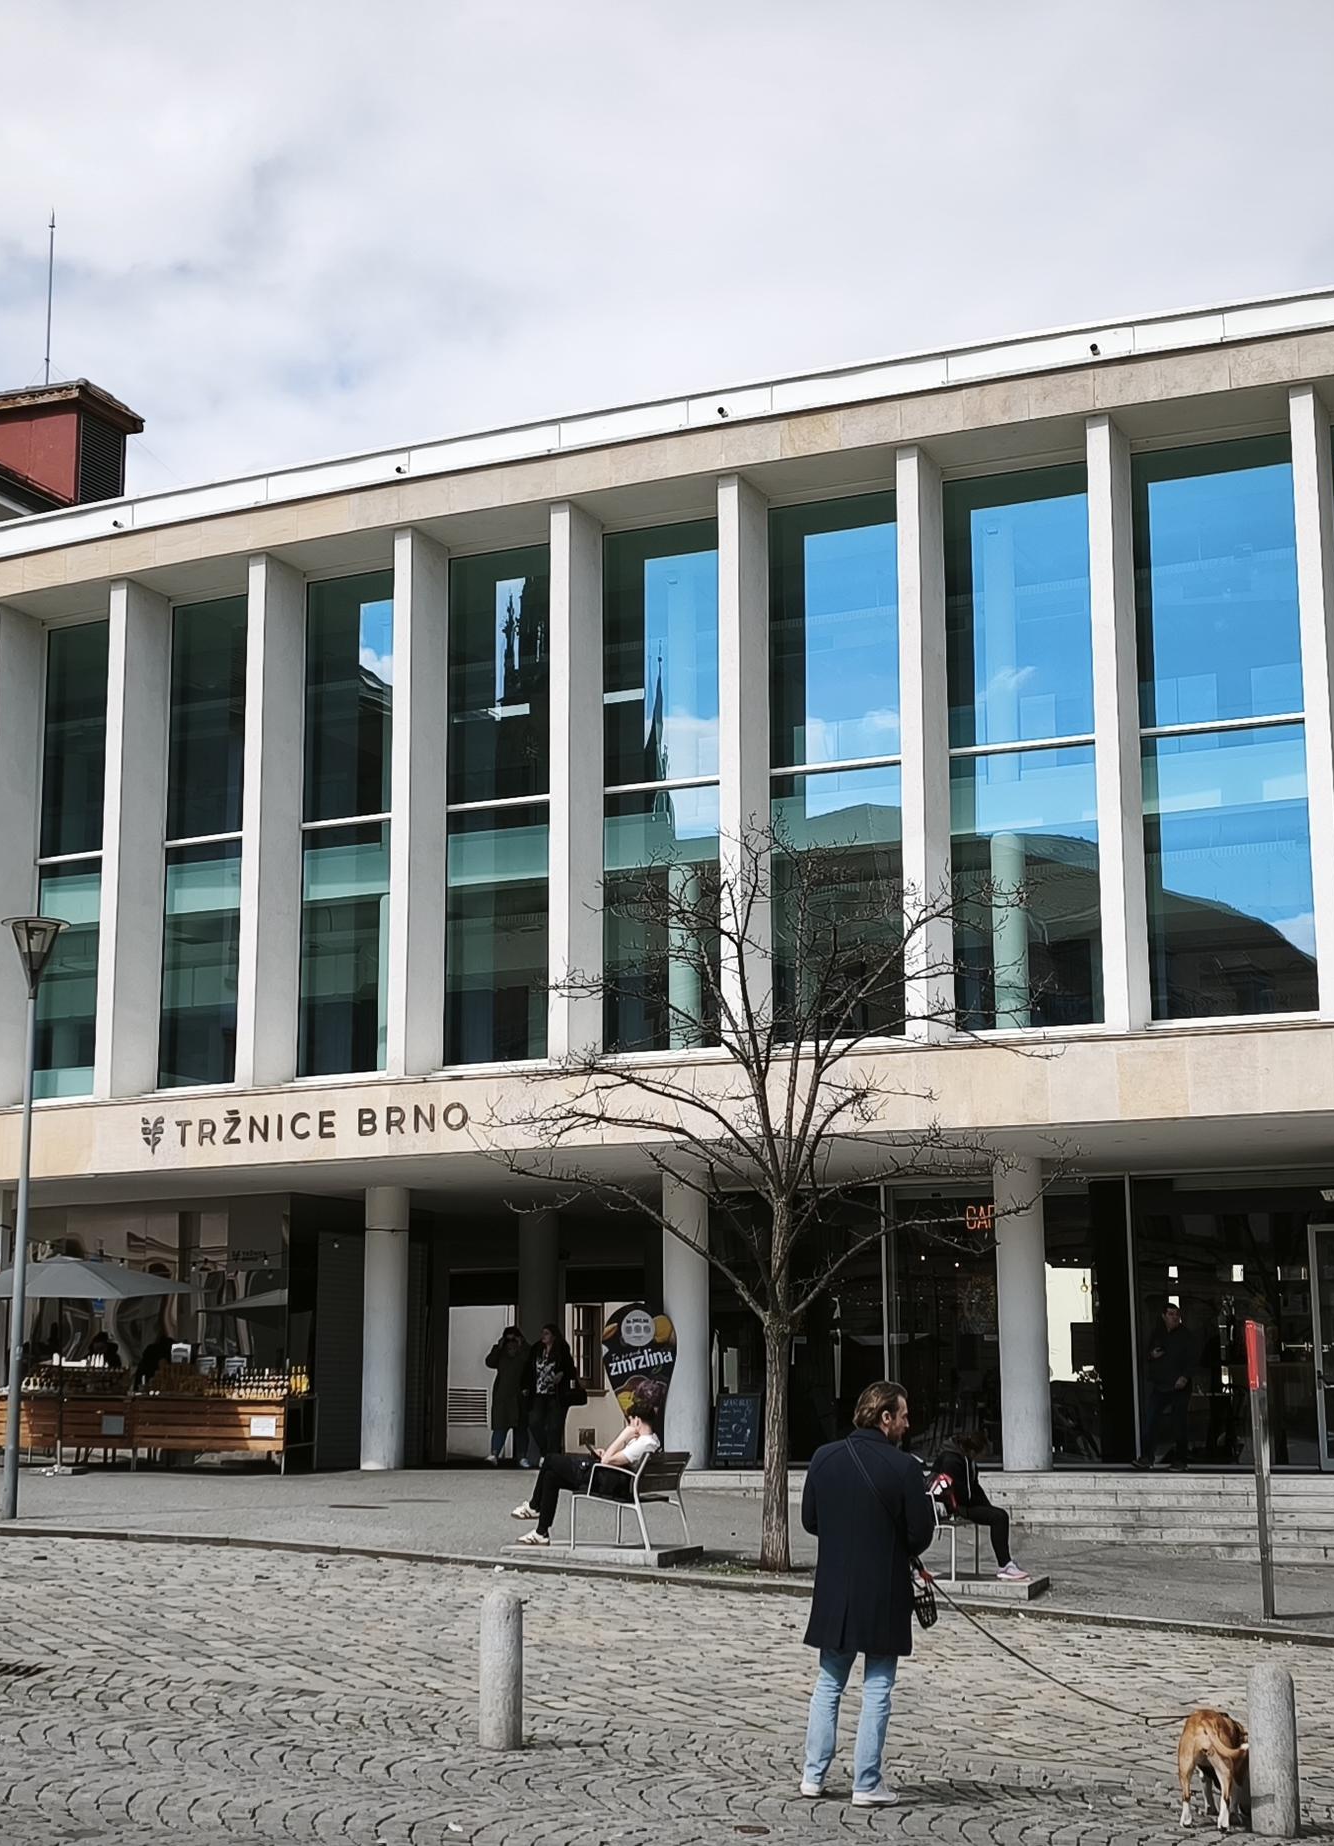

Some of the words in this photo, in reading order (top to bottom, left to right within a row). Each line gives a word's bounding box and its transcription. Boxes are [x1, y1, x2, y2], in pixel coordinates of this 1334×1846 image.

[175, 1109, 336, 1148] TRŽNICE
[357, 1102, 469, 1137] BRNO
[966, 1204, 995, 1230] CAF
[608, 1348, 674, 1377] zmrzlina
